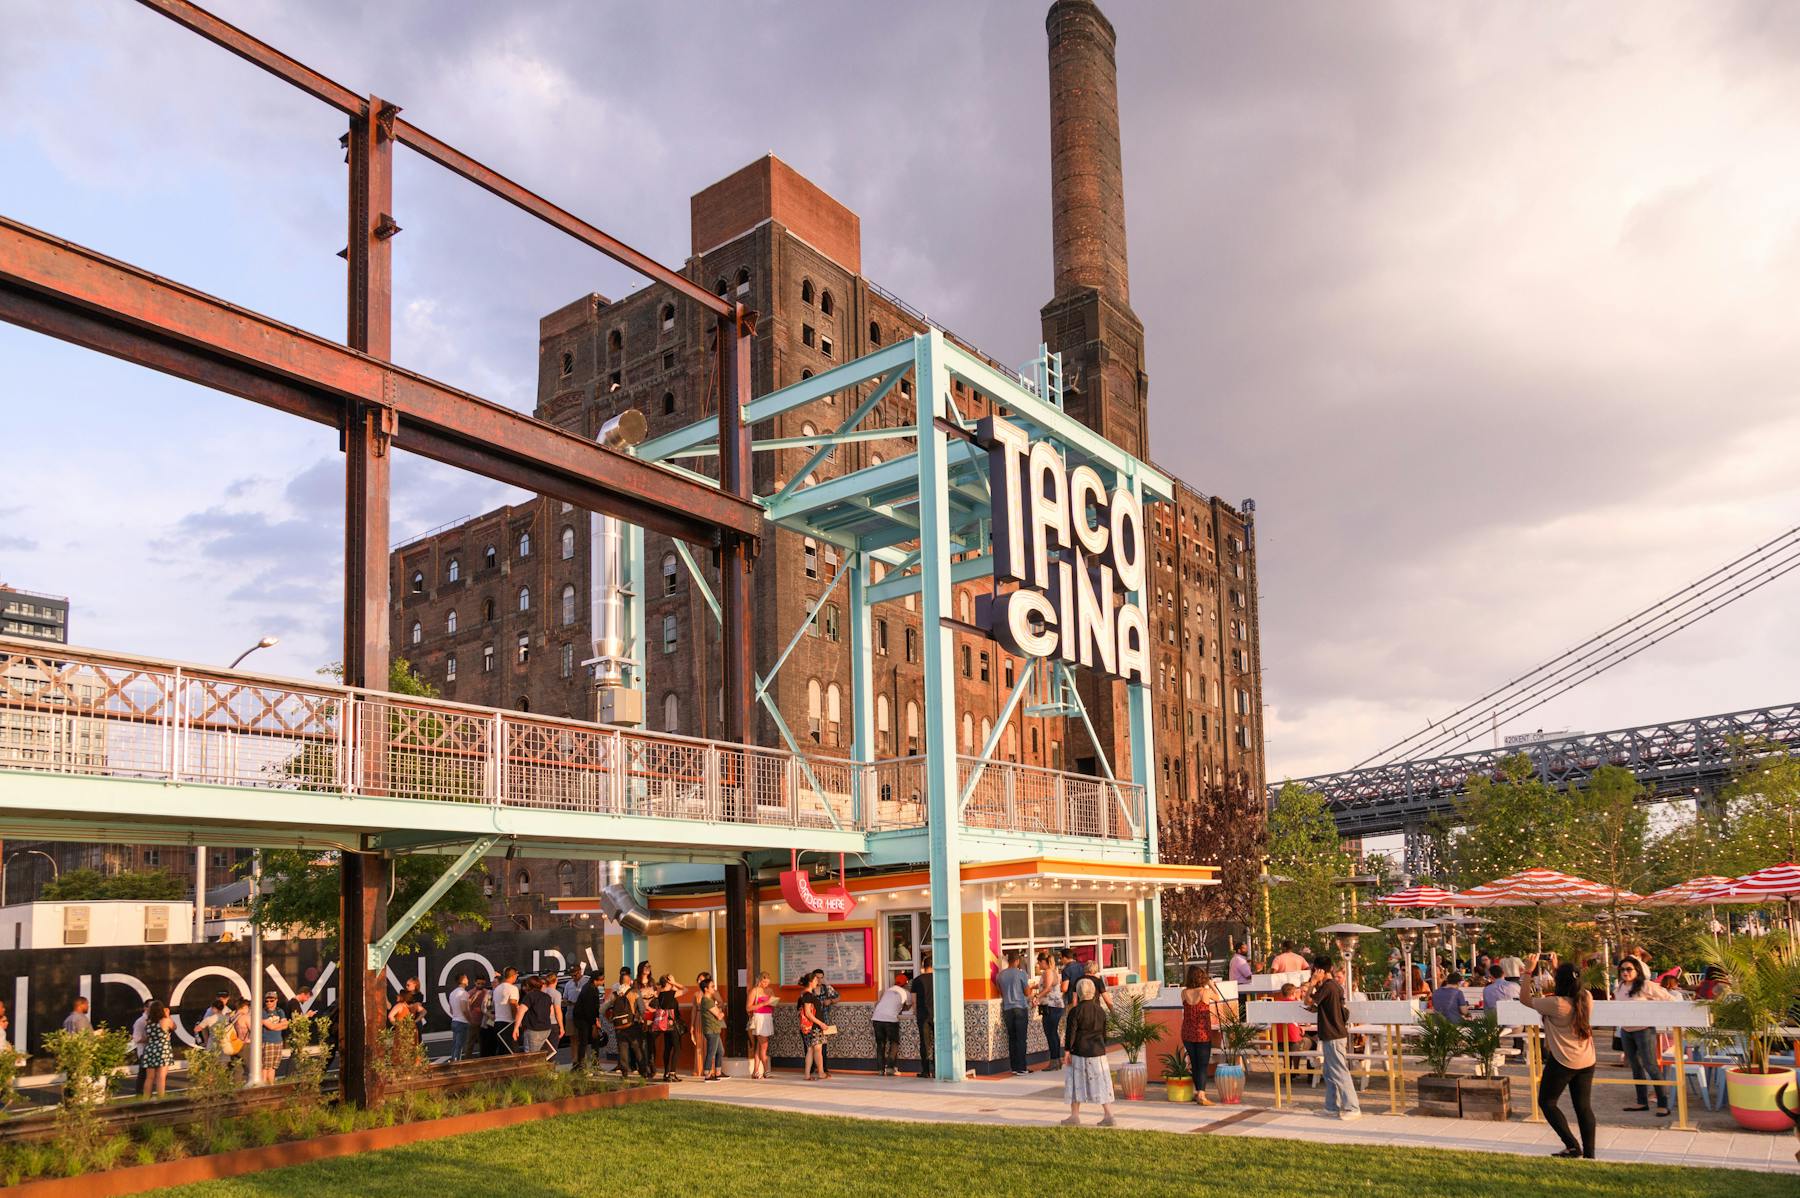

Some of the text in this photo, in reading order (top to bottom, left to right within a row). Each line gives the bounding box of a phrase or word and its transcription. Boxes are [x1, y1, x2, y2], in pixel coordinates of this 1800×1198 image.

[992, 415, 1145, 593] TACO
[1007, 545, 1152, 687] CINA
[799, 879, 846, 910] ORDER HERE
